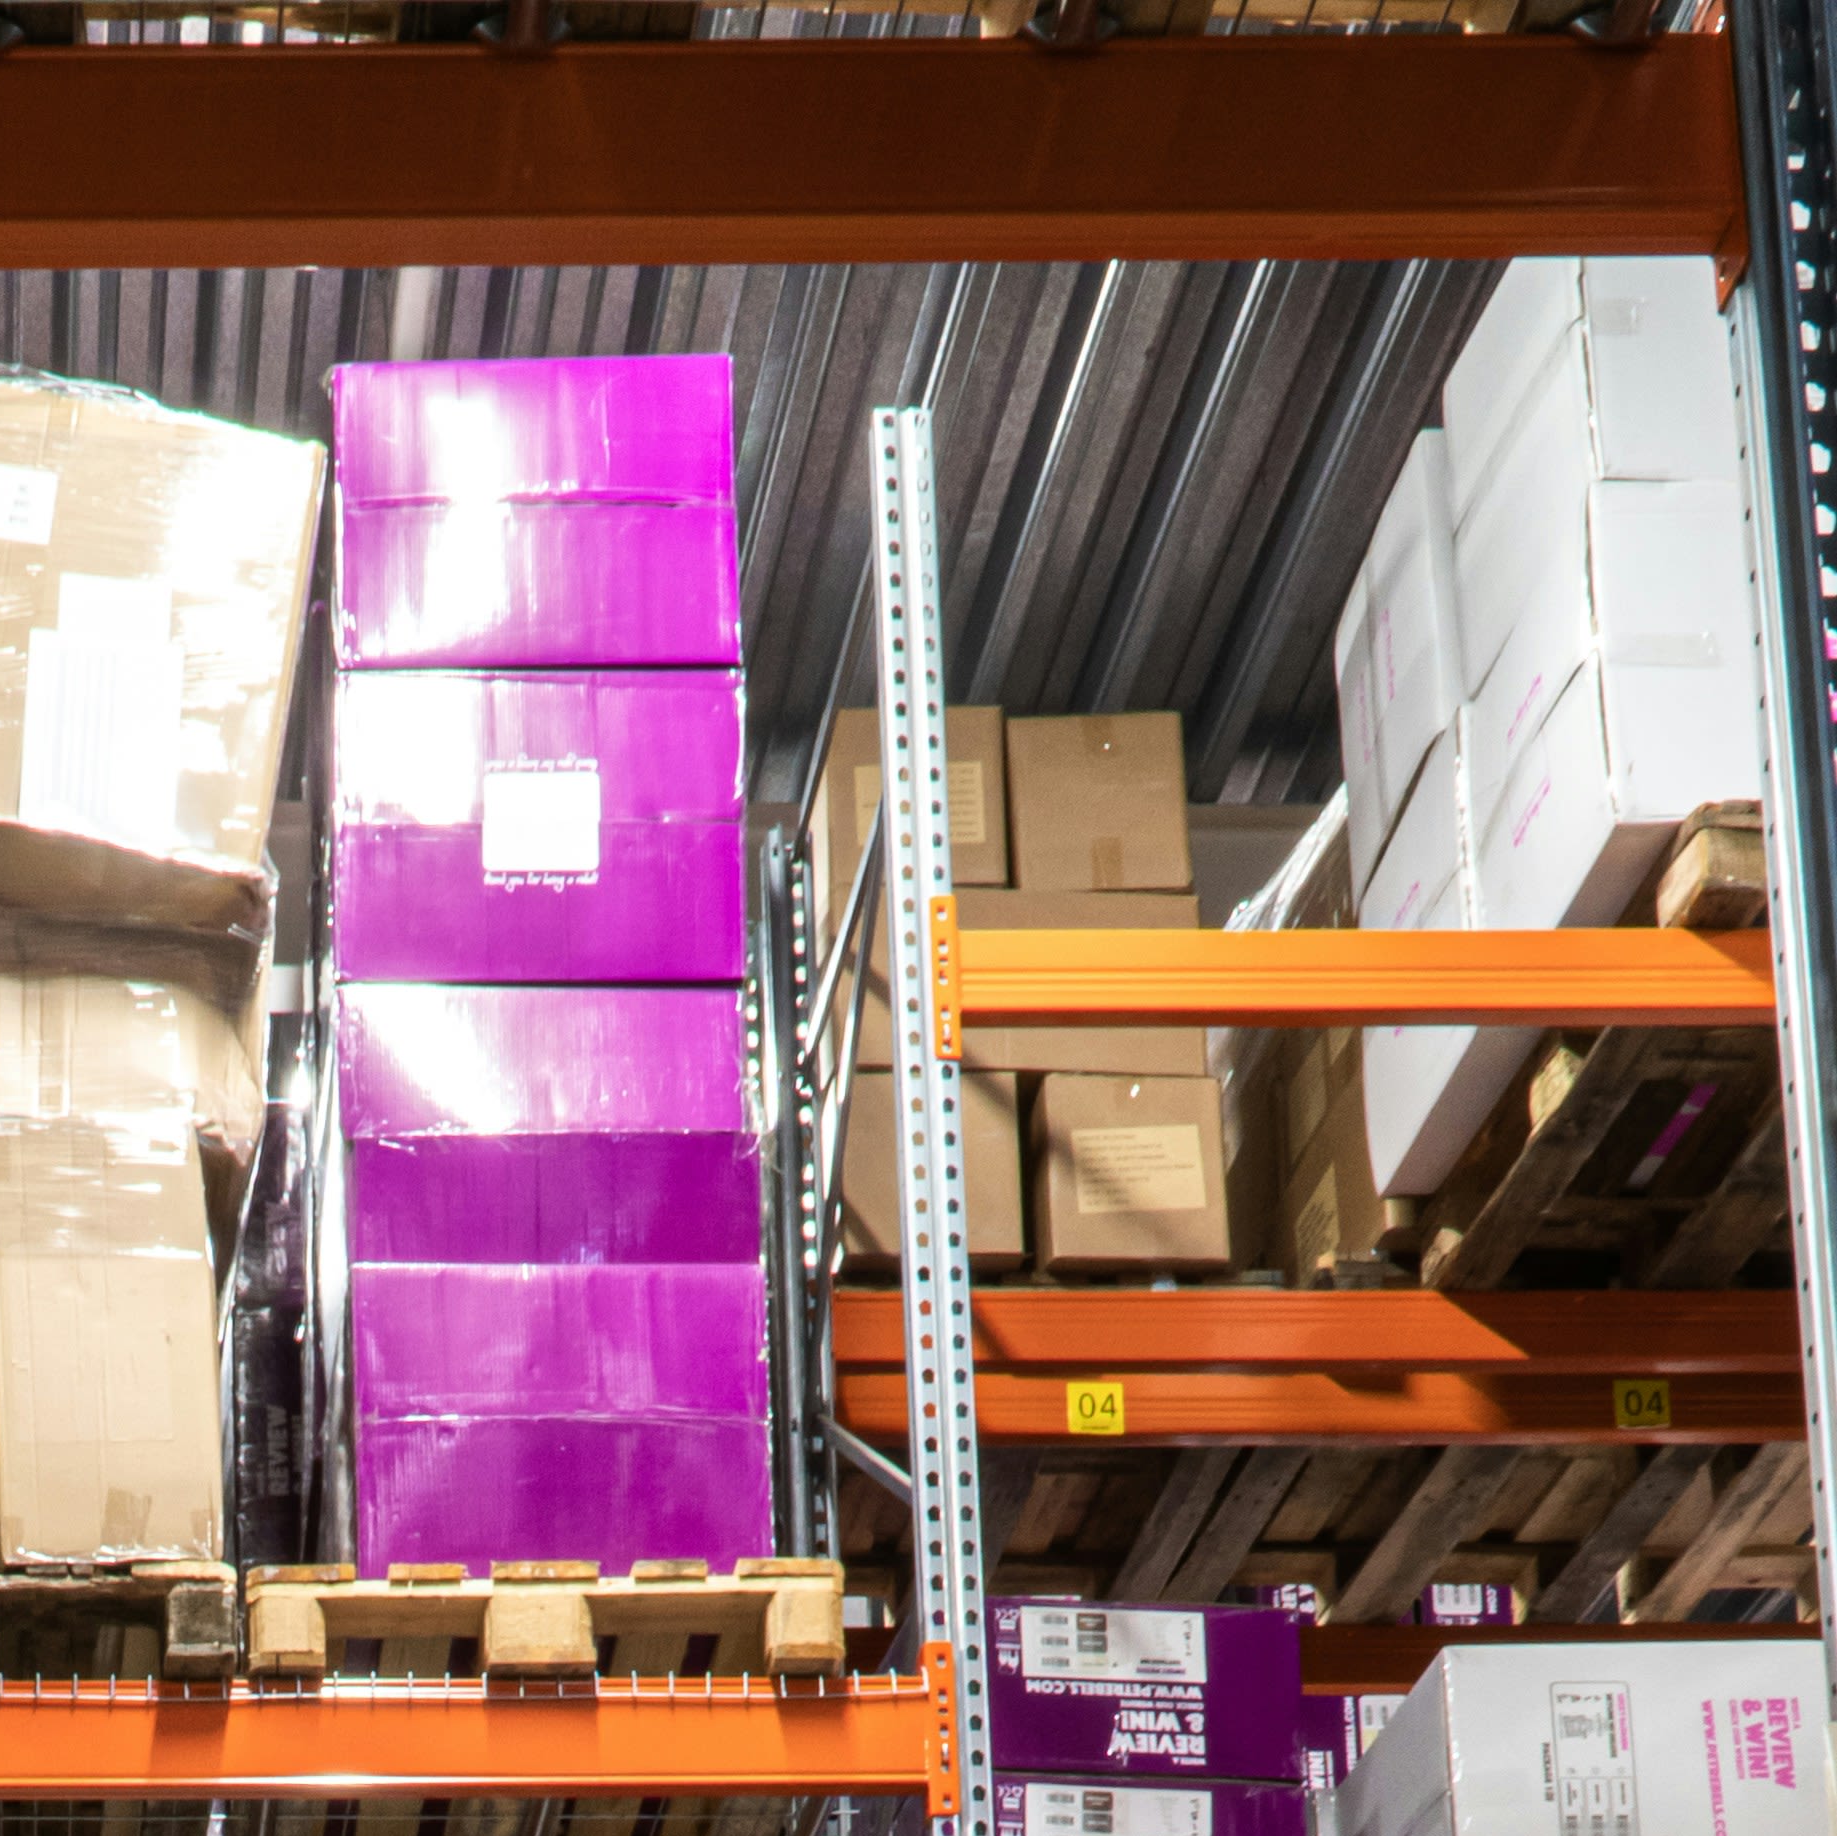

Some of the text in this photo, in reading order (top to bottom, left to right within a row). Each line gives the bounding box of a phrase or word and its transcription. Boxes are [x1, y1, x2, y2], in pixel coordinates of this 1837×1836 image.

[1077, 1391, 1119, 1420] 04
[1623, 1388, 1665, 1418] 04
[1025, 1680, 1203, 1700] WWW.PETREBELS.COM
[1120, 1710, 1205, 1733] & WIN!
[1108, 1733, 1206, 1755] REVIEW
[1741, 1698, 1770, 1780] & WIN!
[1766, 1697, 1797, 1790] REVIEW
